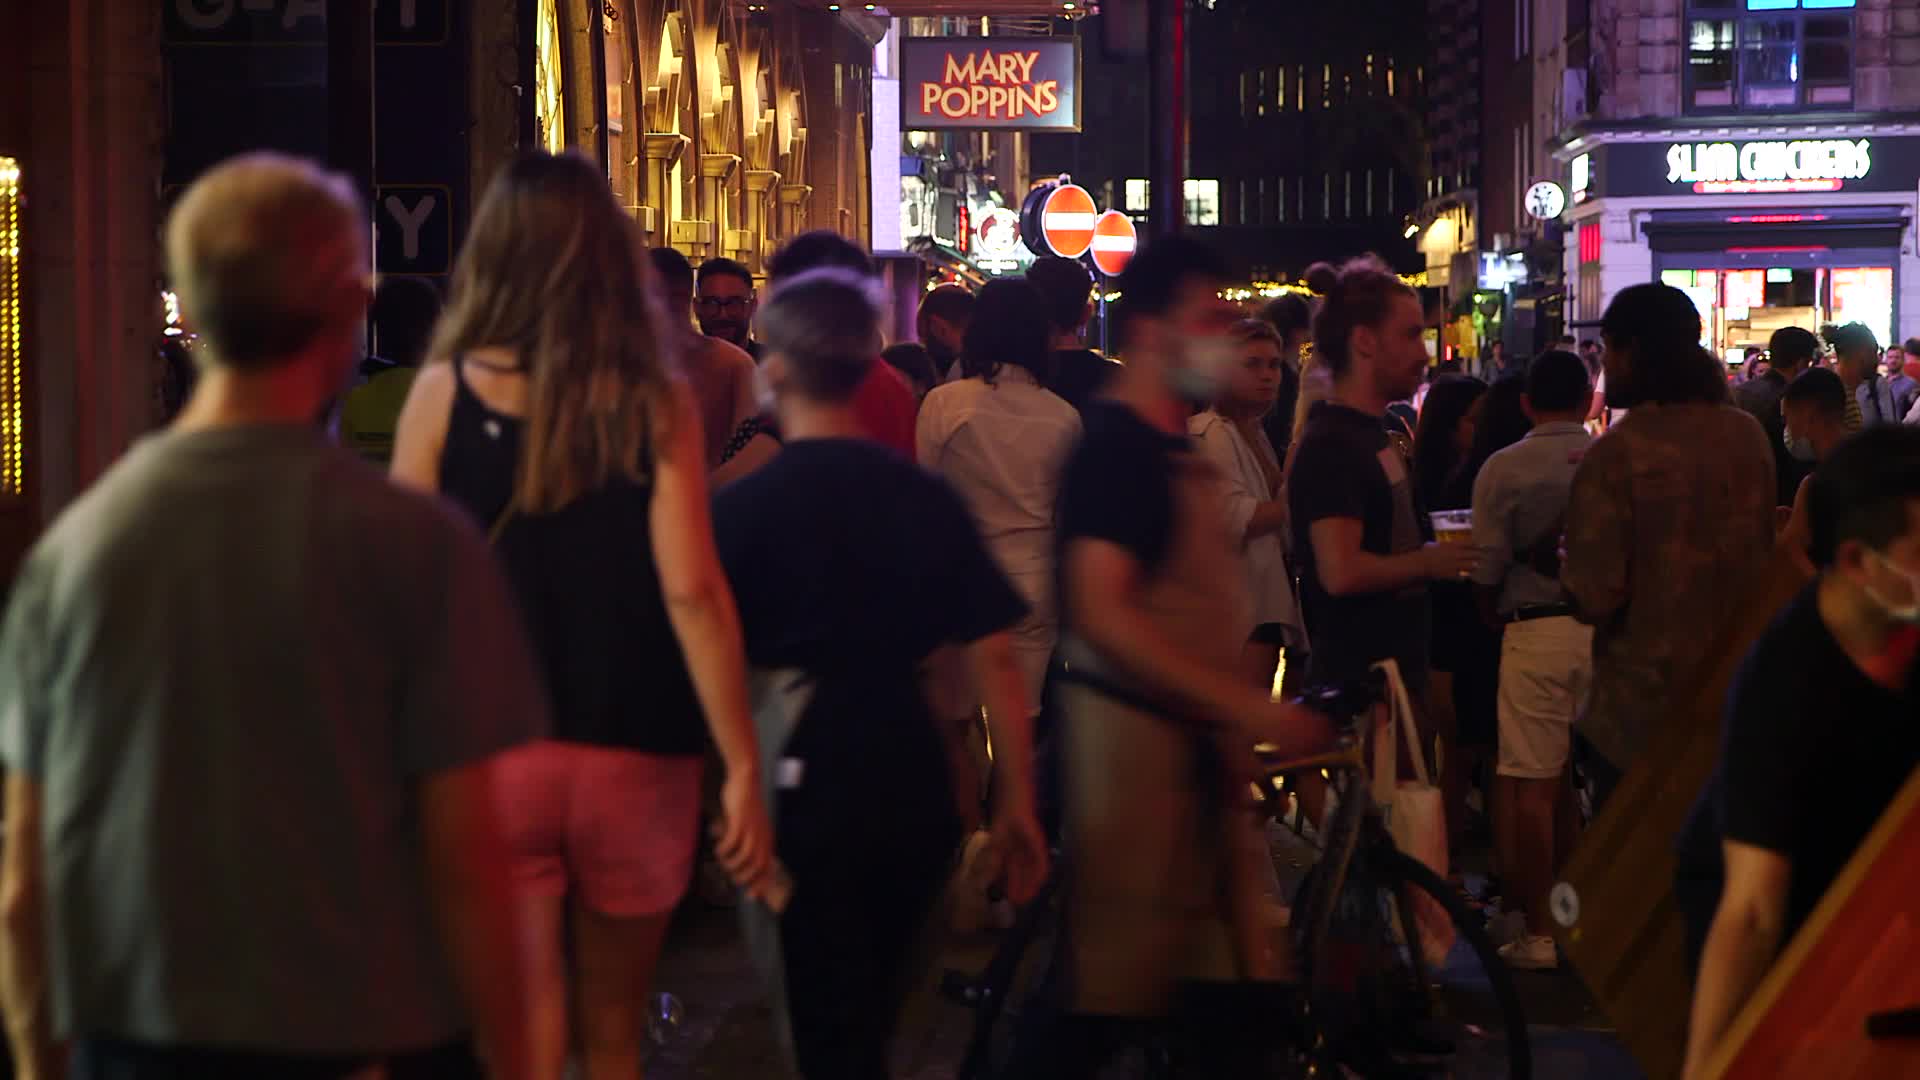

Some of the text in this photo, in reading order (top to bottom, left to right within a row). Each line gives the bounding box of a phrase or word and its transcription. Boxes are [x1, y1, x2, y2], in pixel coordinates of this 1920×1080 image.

[944, 49, 1041, 85] MARY
[921, 80, 1058, 119] POPPINS
[1667, 143, 1738, 182] SLIM
